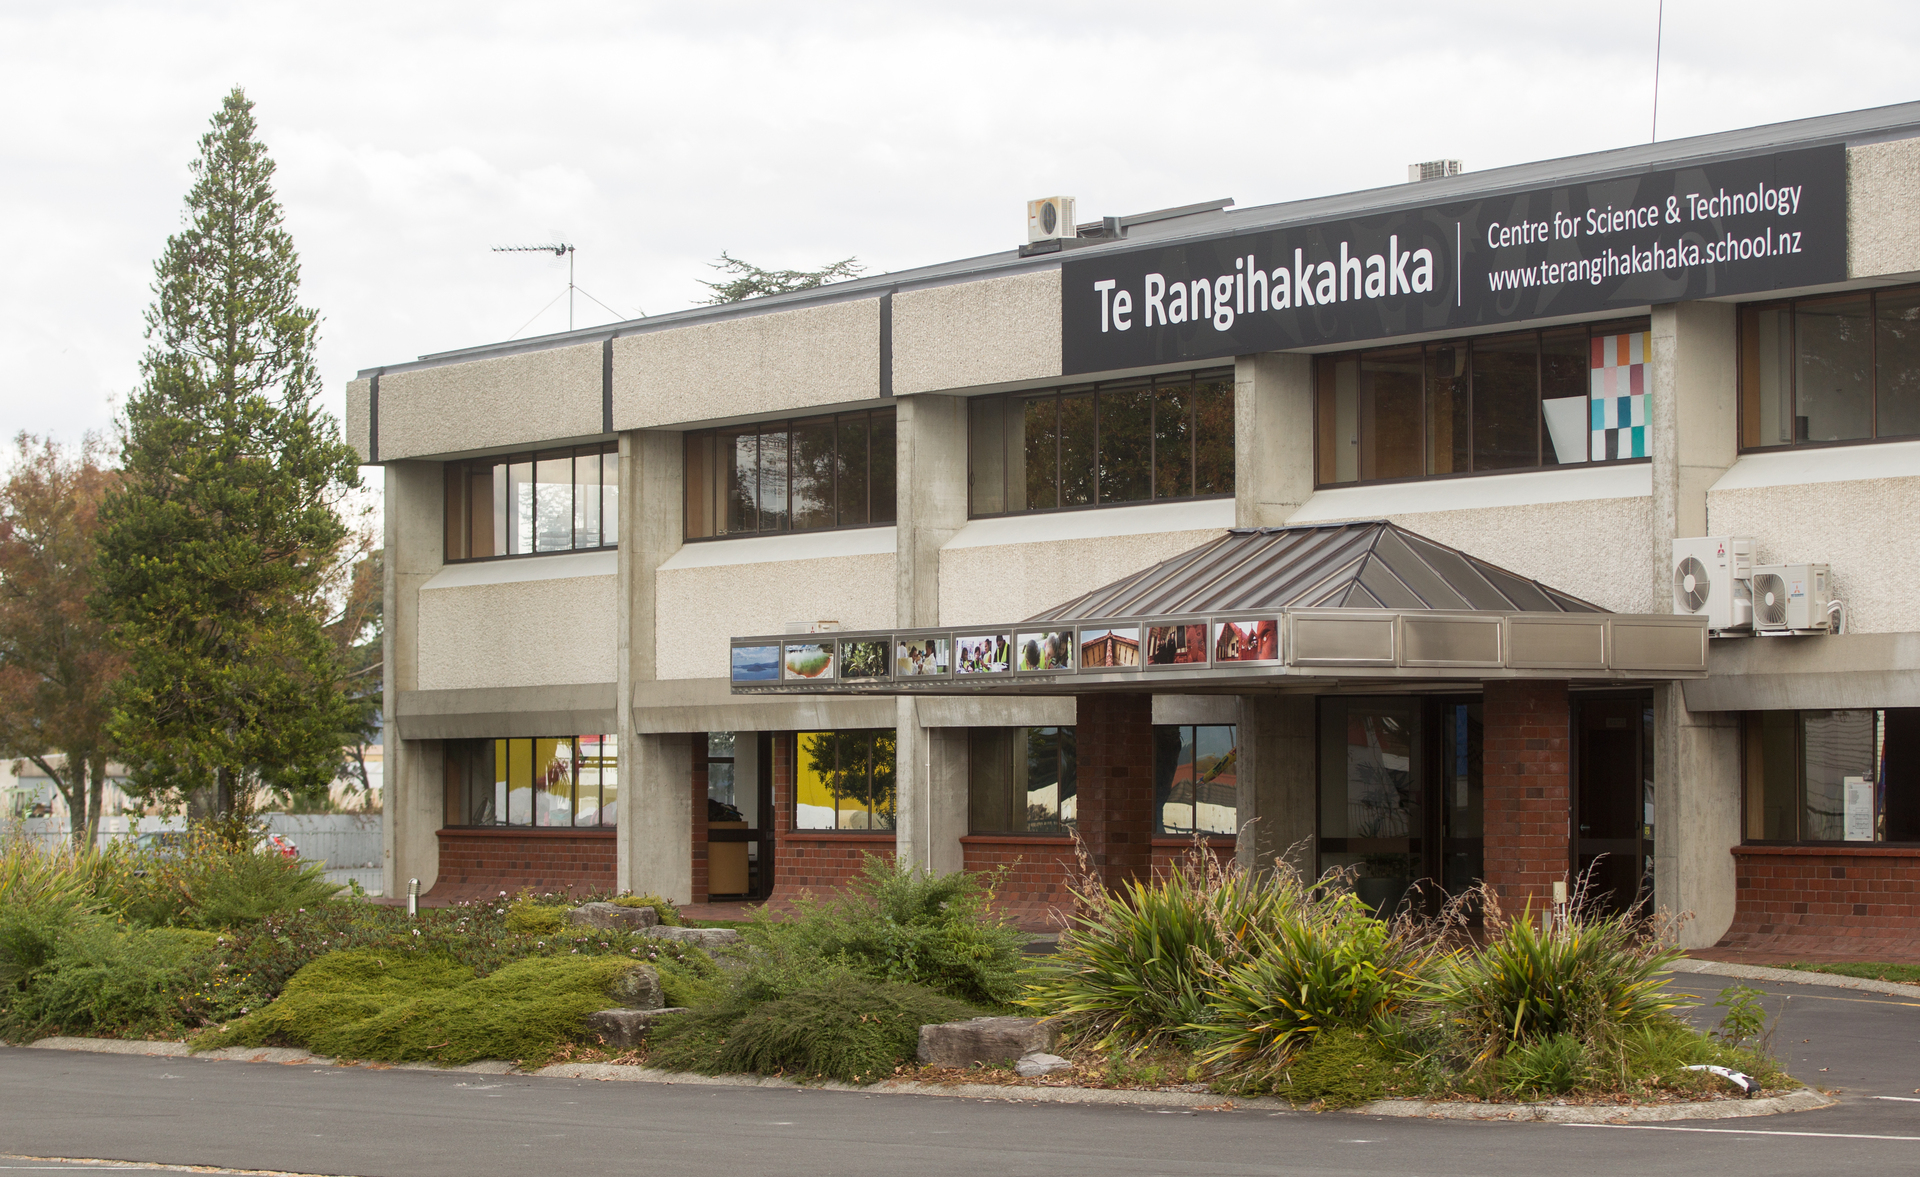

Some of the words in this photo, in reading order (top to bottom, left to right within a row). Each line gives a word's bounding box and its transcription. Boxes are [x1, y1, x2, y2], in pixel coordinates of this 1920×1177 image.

[1487, 219, 1549, 249] Centre
[1553, 211, 1582, 239] for
[1586, 203, 1659, 236] Science
[1664, 195, 1682, 224] &
[1685, 182, 1802, 222] Technology
[1094, 278, 1133, 333] Te
[1144, 234, 1433, 332] Rangihakahaka
[1488, 226, 1802, 292] www.terangihakahaka.school.nz
